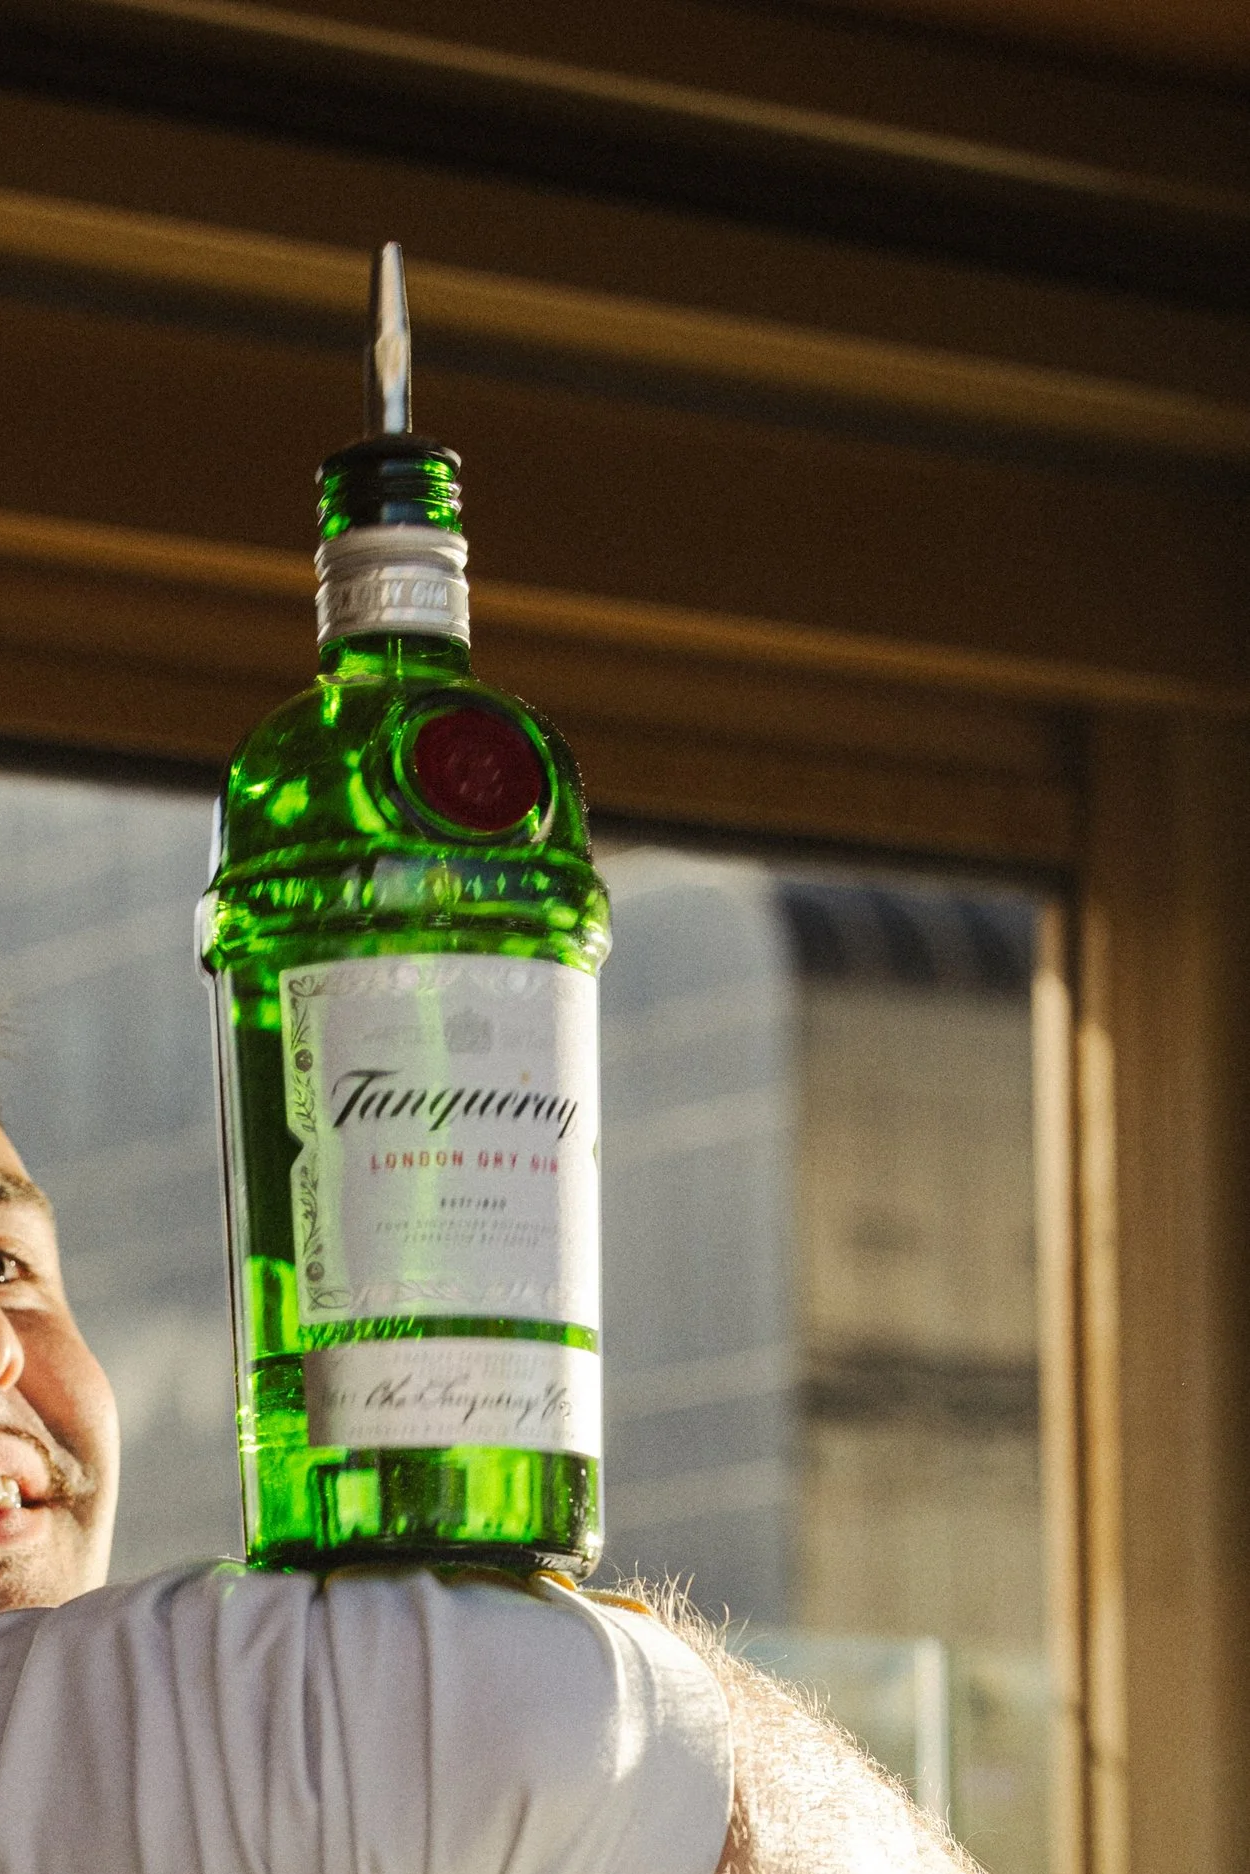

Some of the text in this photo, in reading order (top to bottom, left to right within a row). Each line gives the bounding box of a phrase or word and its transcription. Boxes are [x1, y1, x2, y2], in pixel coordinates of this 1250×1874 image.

[331, 1068, 578, 1140] Tanqueray
[370, 1150, 464, 1175] LONDON
[477, 1150, 518, 1173] DRY
